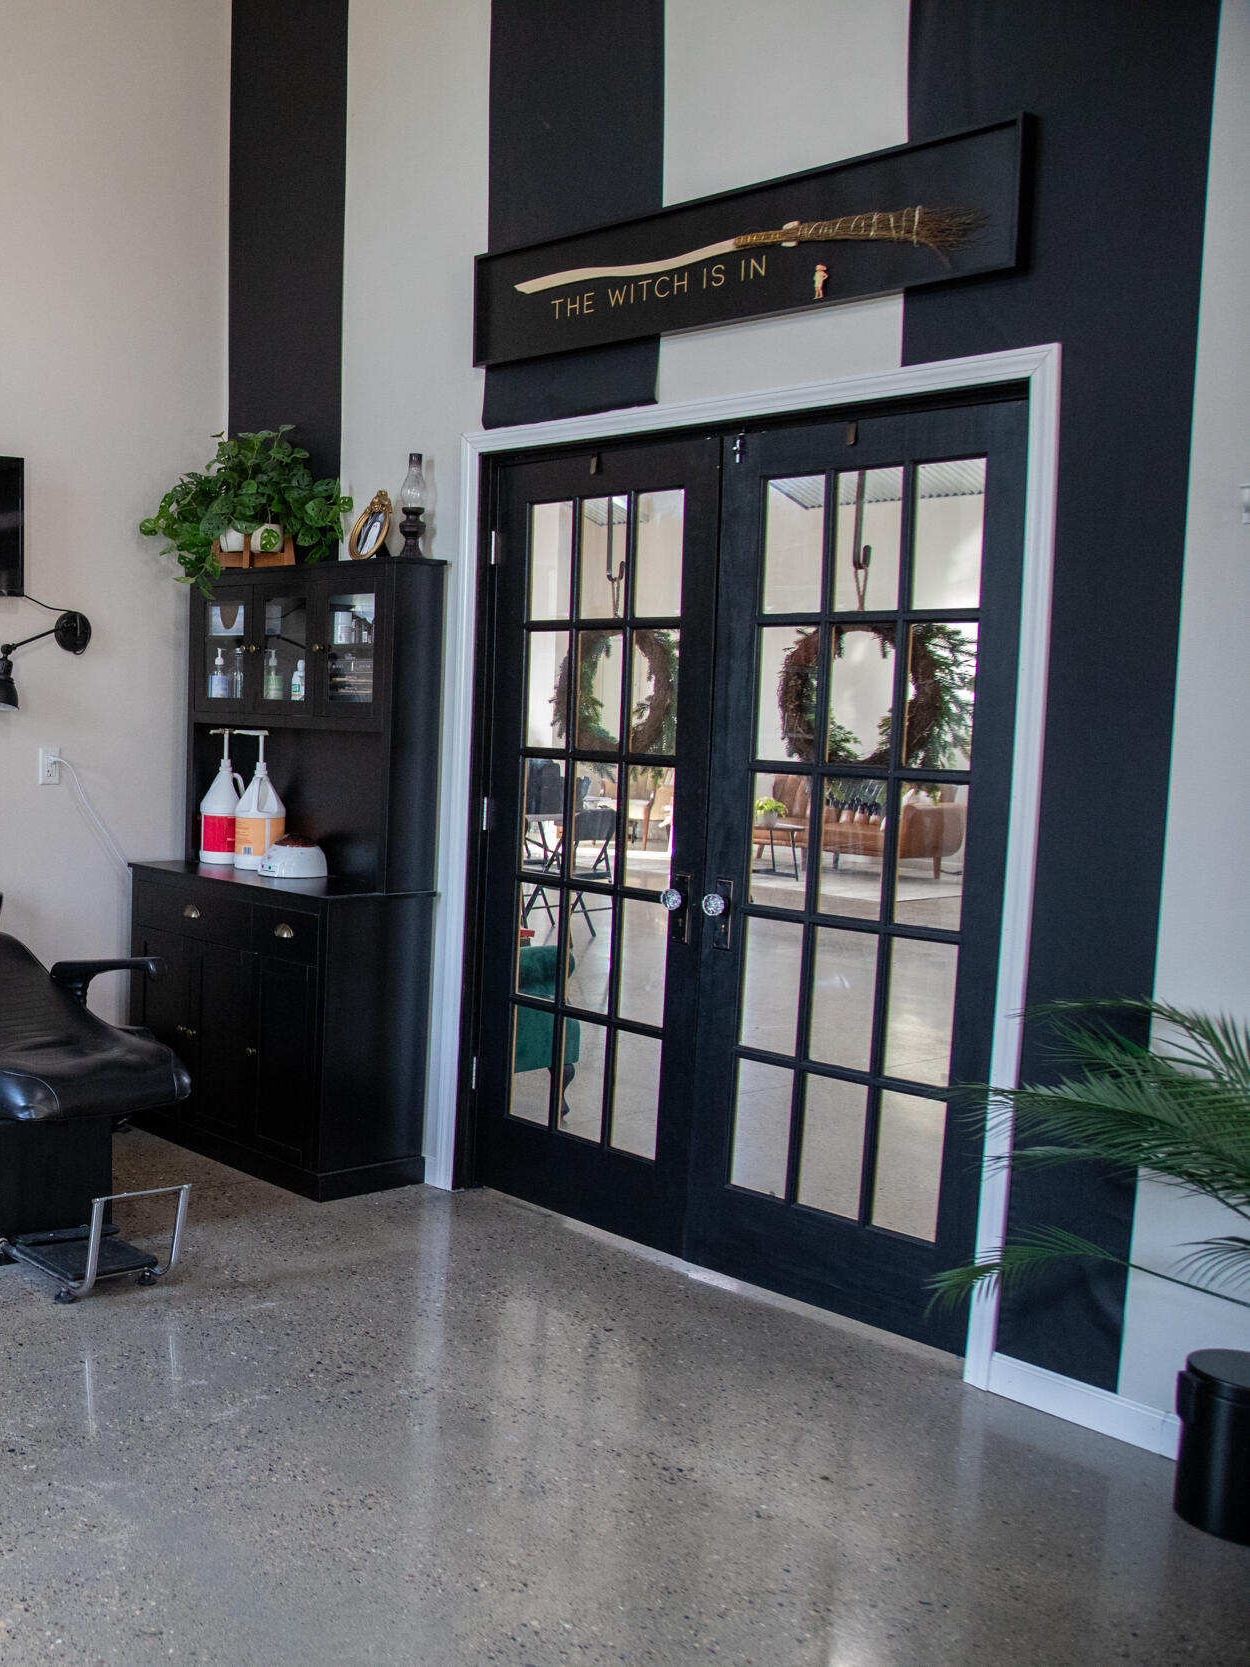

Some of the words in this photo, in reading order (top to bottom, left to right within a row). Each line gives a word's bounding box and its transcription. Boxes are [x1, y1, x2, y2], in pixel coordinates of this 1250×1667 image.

[551, 292, 595, 320] THE
[608, 272, 688, 307] WITCH
[703, 264, 725, 288] IS
[740, 255, 766, 281] IN
